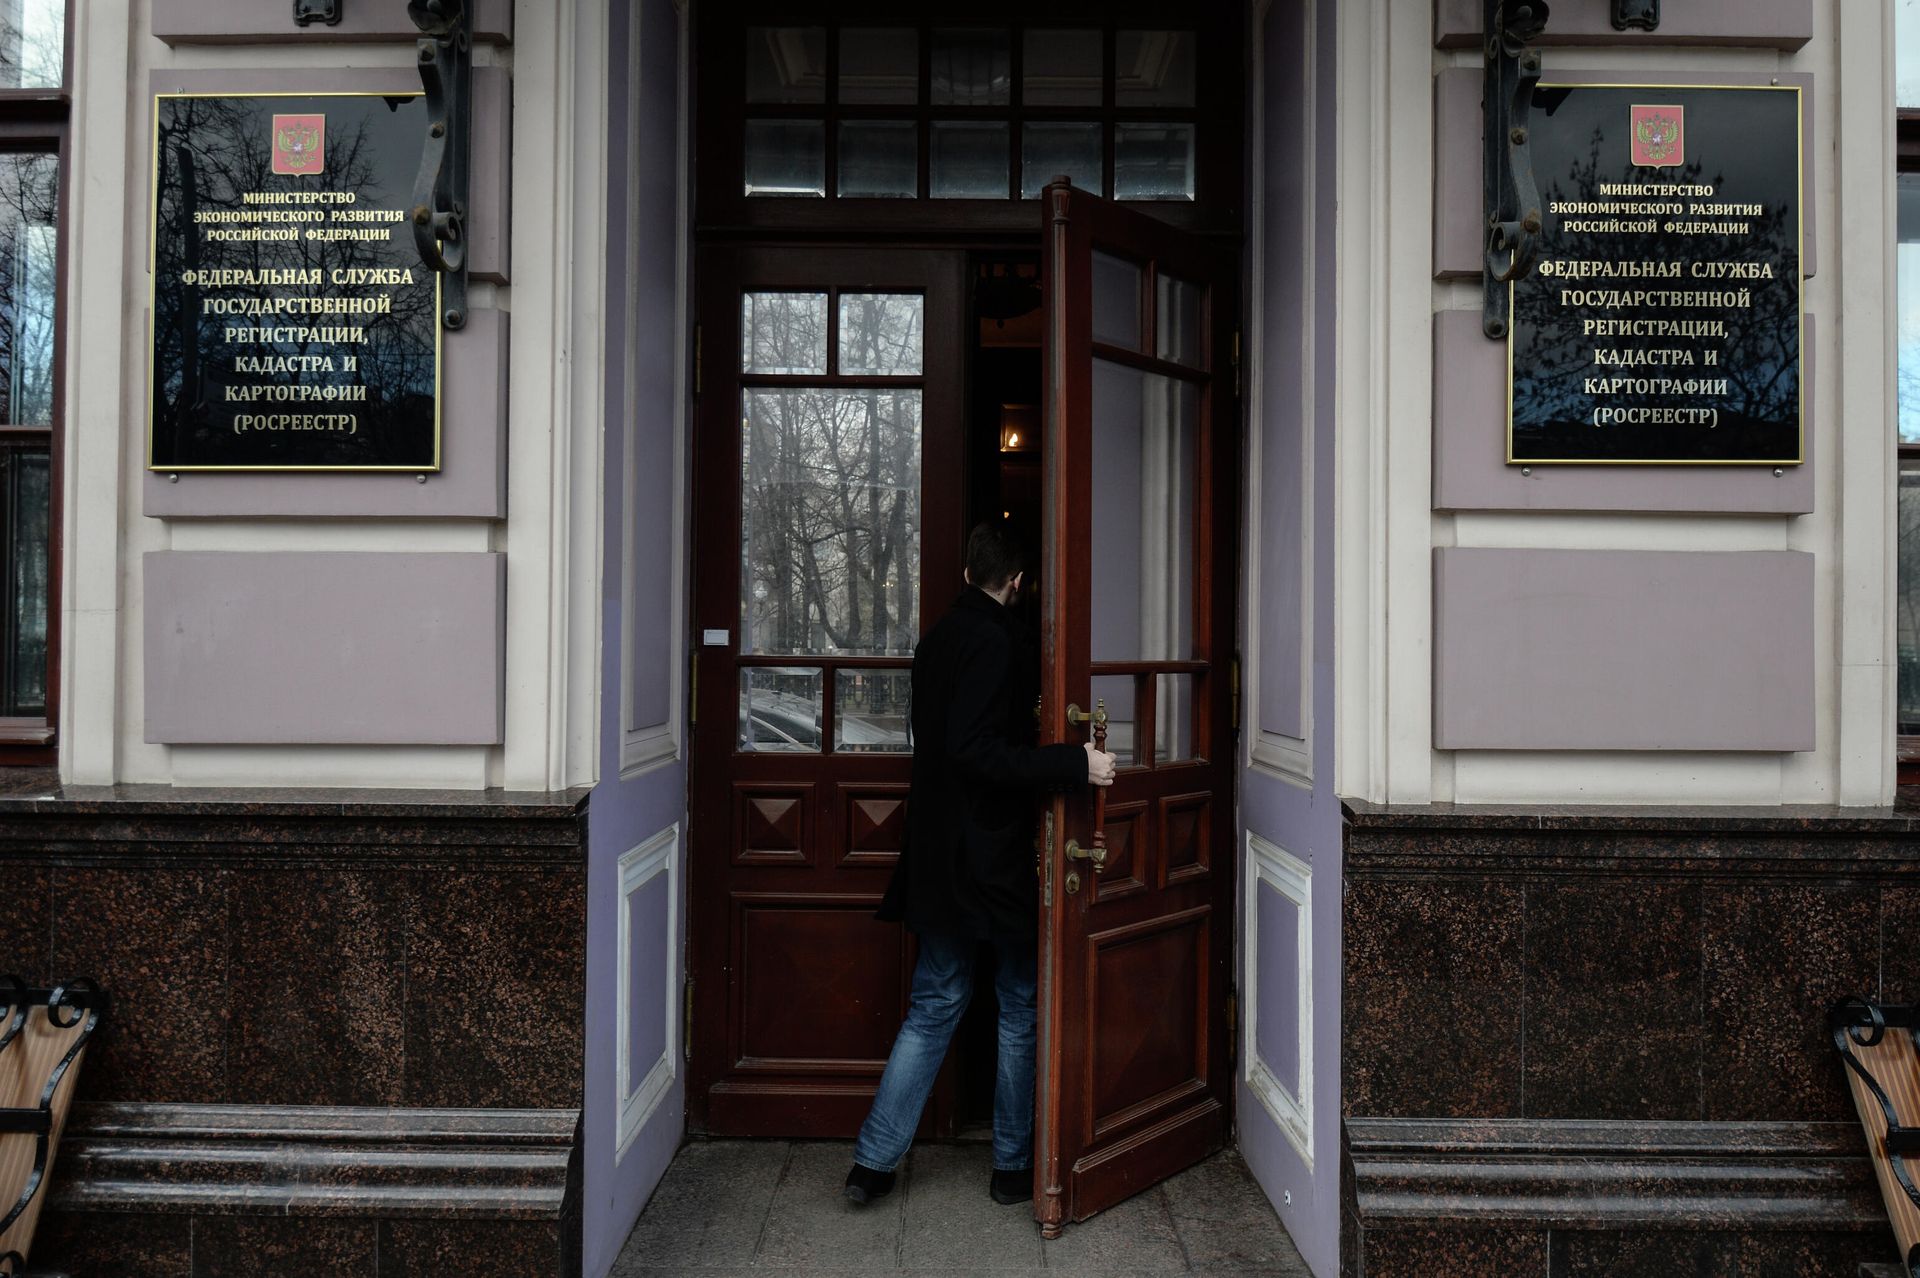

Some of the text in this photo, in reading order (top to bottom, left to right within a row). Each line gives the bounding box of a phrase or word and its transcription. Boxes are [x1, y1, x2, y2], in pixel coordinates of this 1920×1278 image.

[243, 192, 356, 204] МИНИСТЕРСТВО
[1599, 184, 1713, 196] МИНИСТЕРСТВО
[193, 211, 404, 224] ЭКОНОМИЧЕСКОГО РАЗВИТИЯ
[1550, 202, 1763, 216] ЭКОНОМИЧЕСКОГО РАЗВИТИЯ
[207, 228, 390, 242] РОССИЙСКОЙ ФЕДЕРАЦИИ
[1564, 220, 1749, 236] РОССИЙСКОЙ ФЕДЕРАЦИИ
[182, 269, 414, 288] ФЕДЕРАЛЬНАЯ СЛУЖБА
[1539, 261, 1773, 279] ФЕДЕРАЛЬНАЯ СЛУЖБА
[203, 294, 391, 317] ГОСУДАРСТВЕННОЙ
[1561, 288, 1751, 310] ГОСУДАРСТВЕННОЙ
[225, 328, 368, 346] РЕГИСТРАЦИИ,
[1583, 320, 1729, 339] РЕГИСТРАЦИИ,
[235, 356, 357, 375] КАДАСТРА И
[1594, 349, 1718, 368] КАДАСТРА И
[225, 385, 367, 402] КАРТОГРАФИИ
[1584, 379, 1728, 395] КАРТОГРАФИИ
[233, 414, 357, 434] (РОСРЕЕСТР)
[1593, 408, 1718, 428] (РОСРЕЕСТР)
